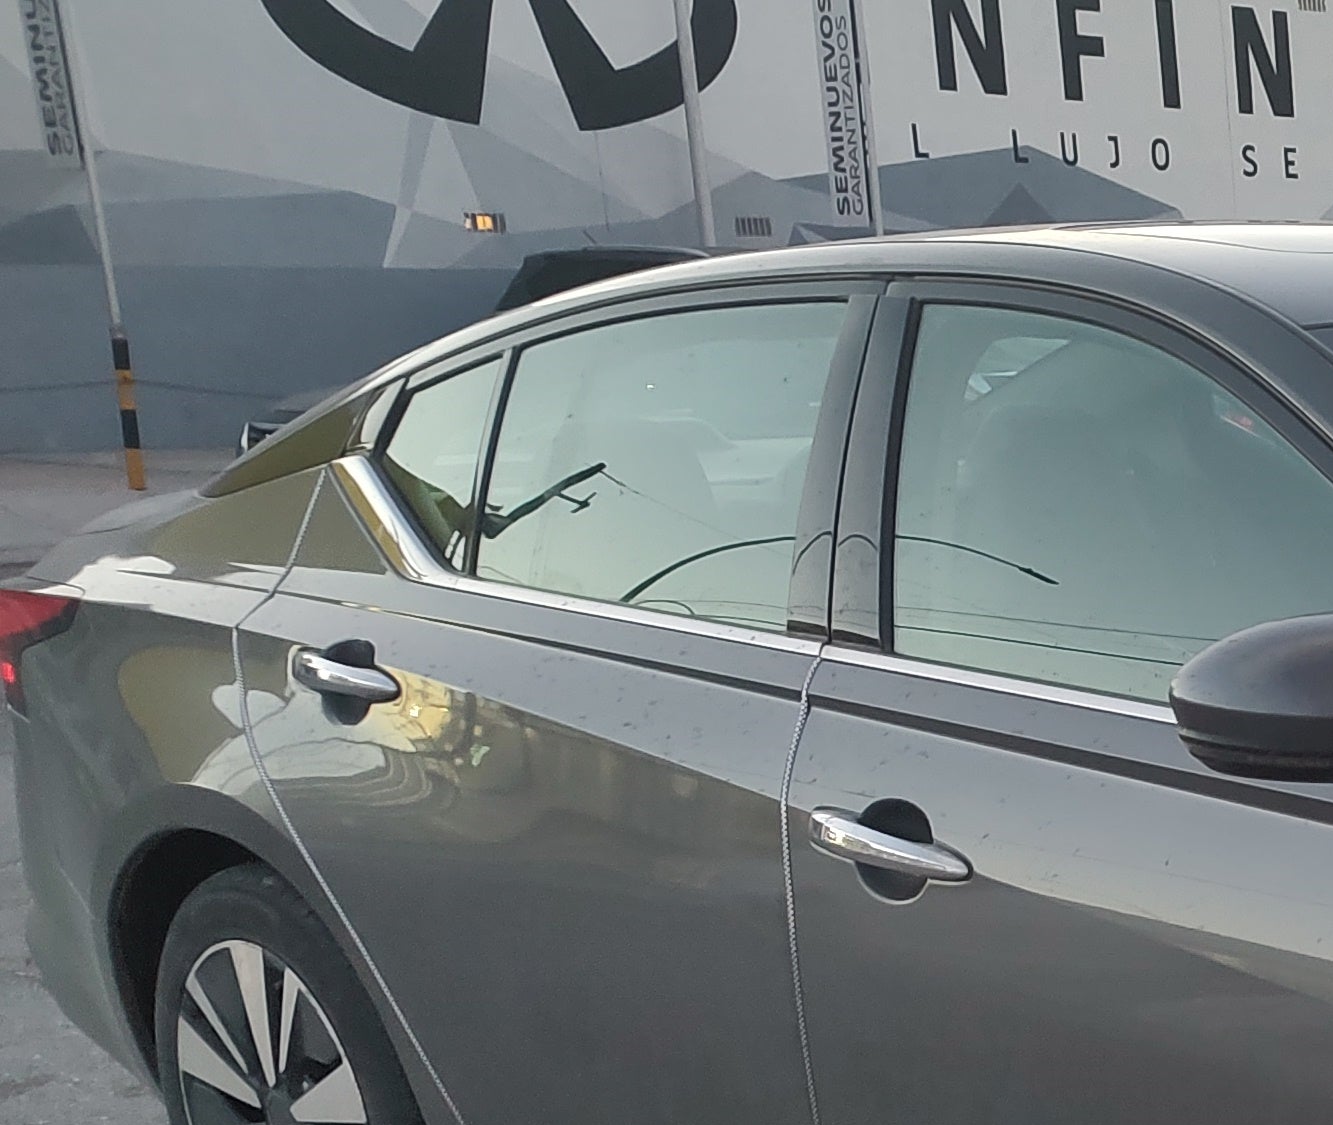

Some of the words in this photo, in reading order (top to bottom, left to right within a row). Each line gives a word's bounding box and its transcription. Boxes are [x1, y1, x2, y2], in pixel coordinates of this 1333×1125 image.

[835, 16, 864, 216] GARANTIZADOS
[1011, 128, 1170, 171] LUJO
[1241, 145, 1299, 180] SE
